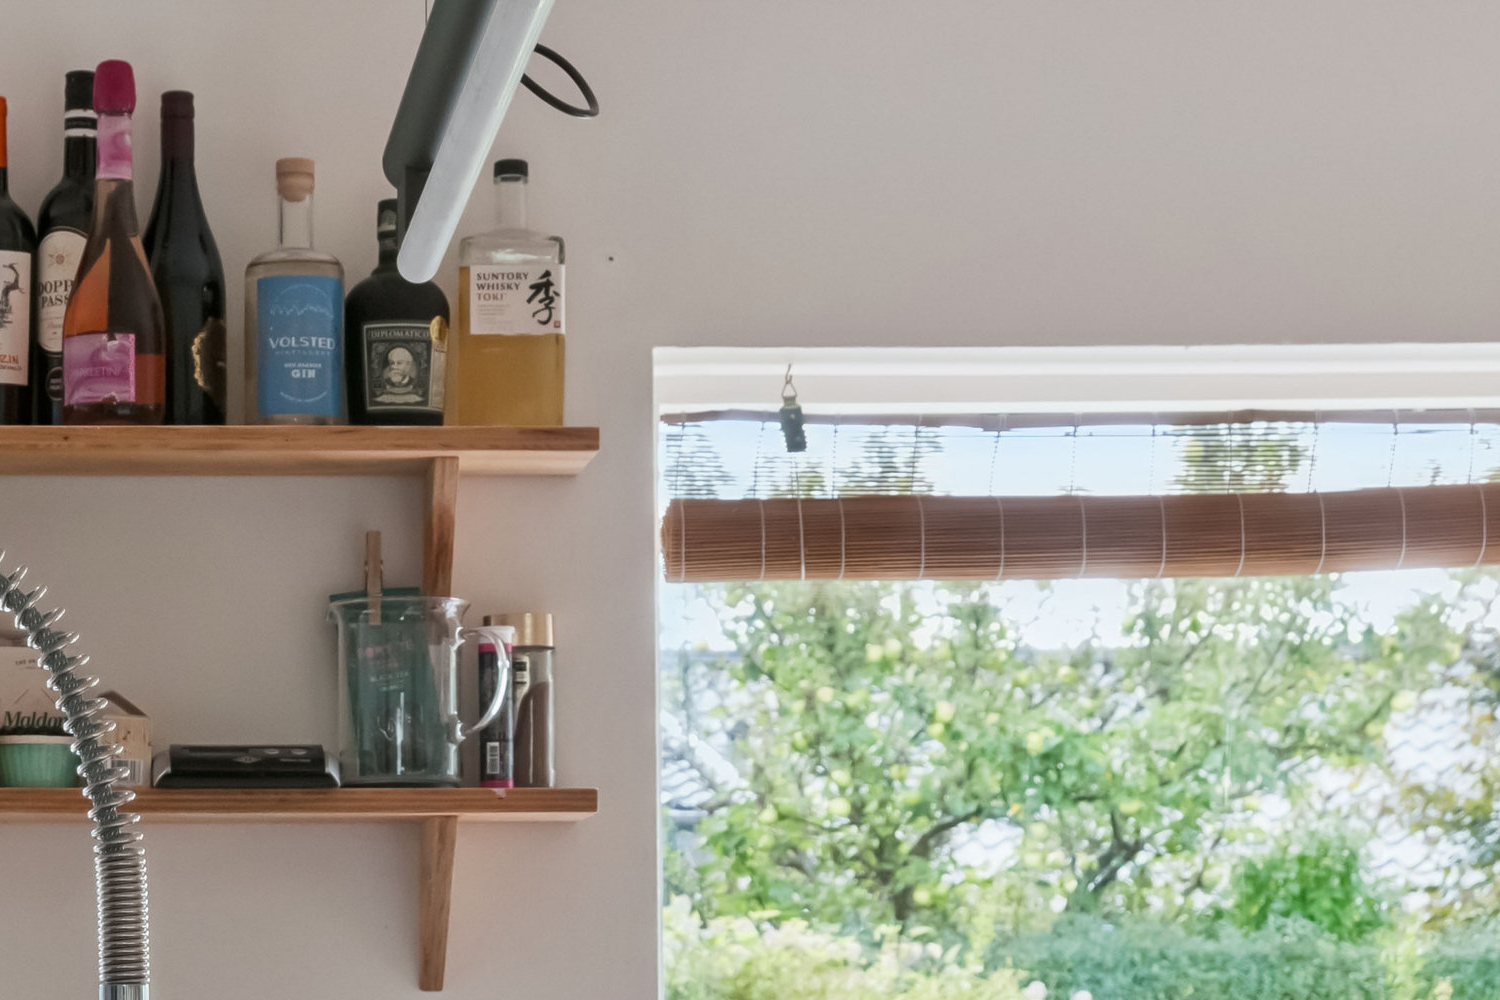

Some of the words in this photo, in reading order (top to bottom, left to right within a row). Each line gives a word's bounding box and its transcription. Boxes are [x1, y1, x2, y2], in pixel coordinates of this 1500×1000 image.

[476, 271, 530, 281] SUNTORY
[38, 279, 75, 296] DOPP
[476, 282, 521, 291] WHISKY
[477, 292, 504, 302] TOKI
[526, 269, 561, 325] 季
[268, 336, 336, 350] VOLSTED
[291, 369, 316, 378] GIN
